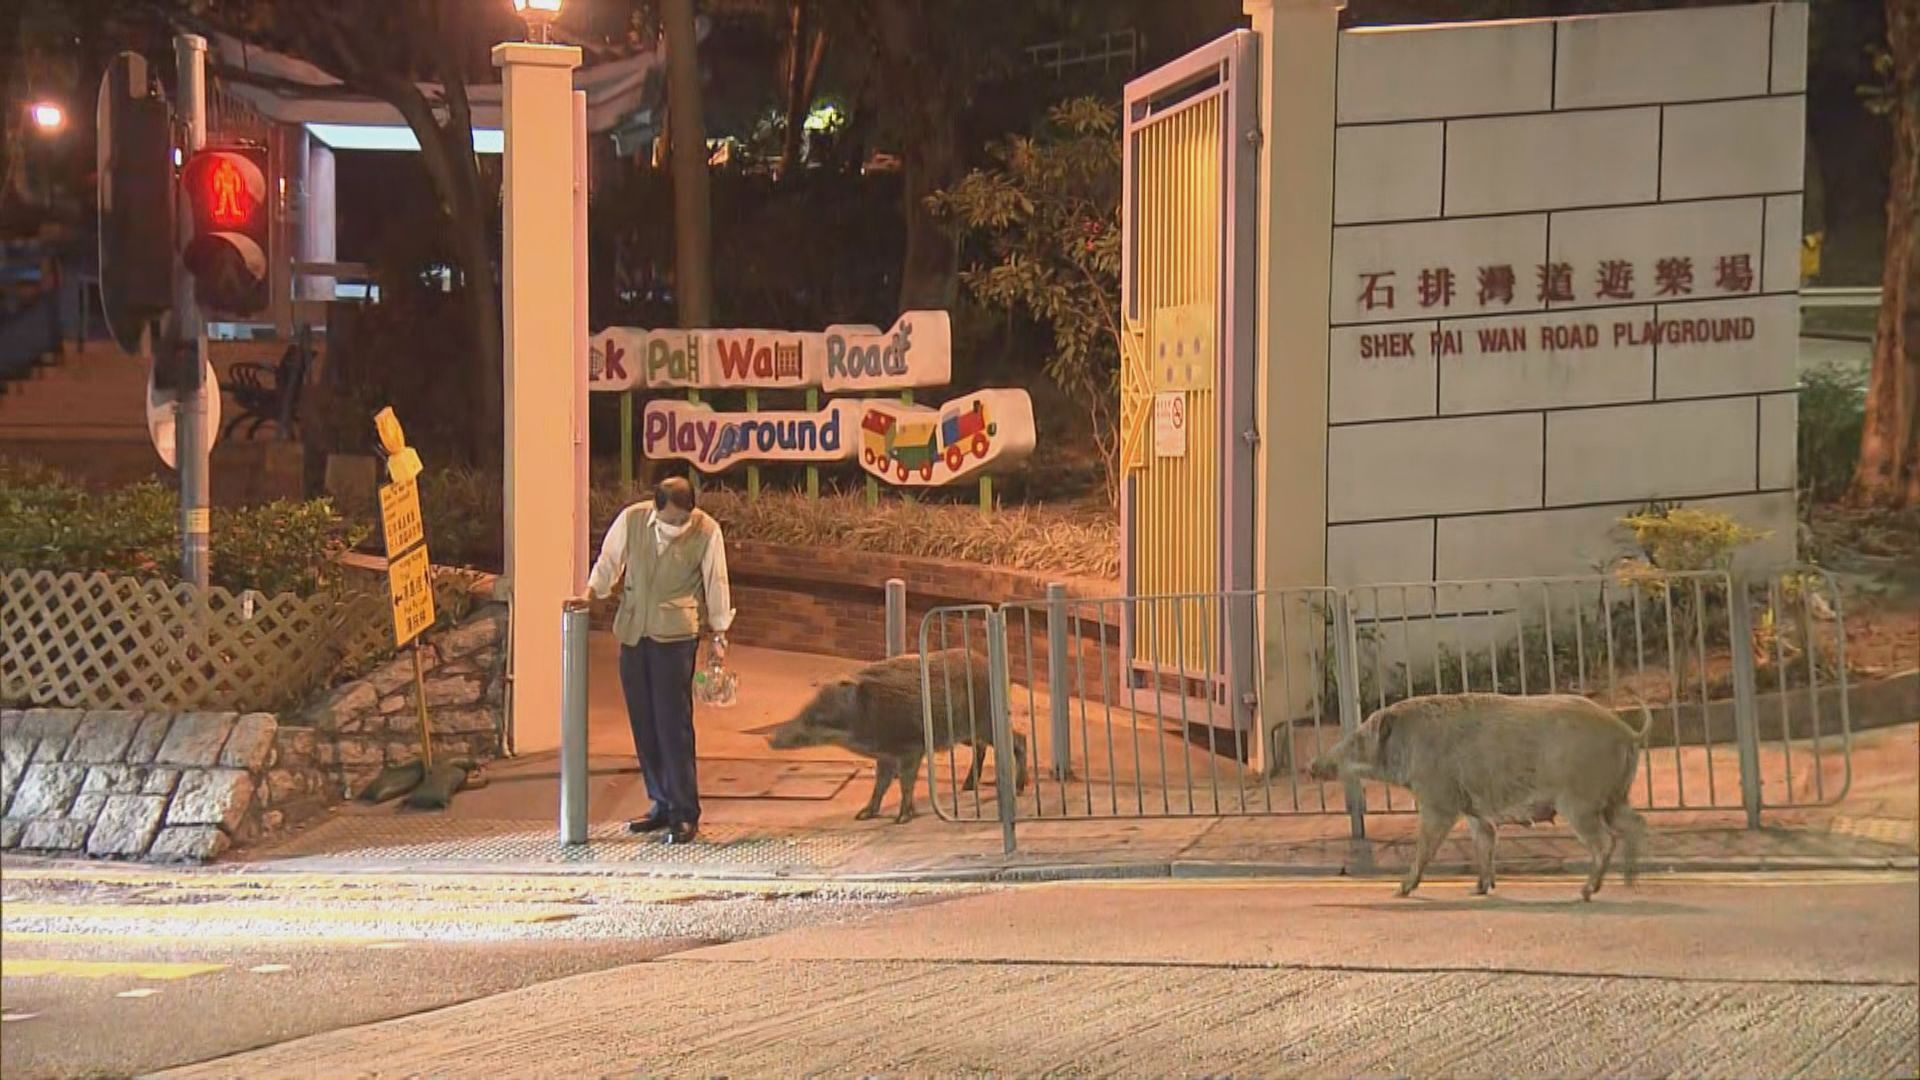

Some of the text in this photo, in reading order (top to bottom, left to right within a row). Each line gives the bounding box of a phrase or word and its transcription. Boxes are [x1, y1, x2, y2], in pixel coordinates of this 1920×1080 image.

[1357, 253, 1754, 311] 石排灣道遊樂場
[826, 320, 912, 379] Road
[1360, 316, 1756, 360] SHEK PAI WAN ROAD PLAYGROUND
[645, 408, 841, 465] Playground
